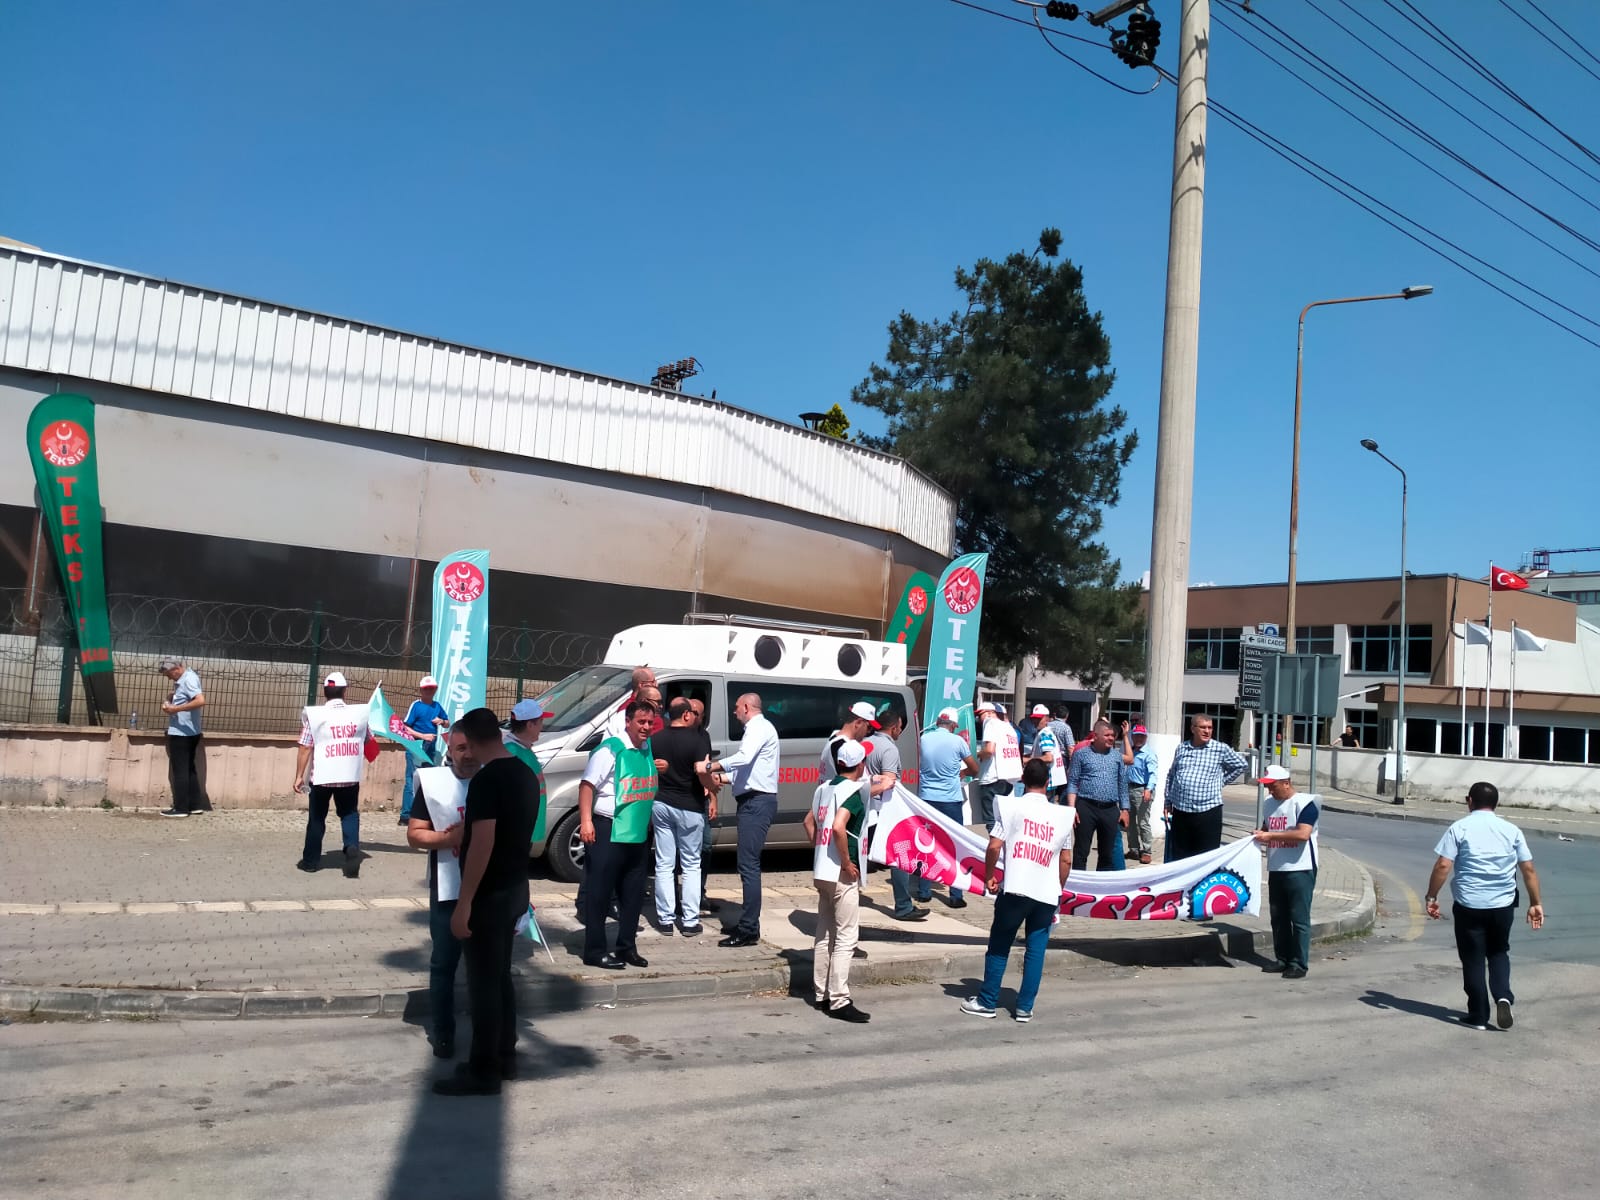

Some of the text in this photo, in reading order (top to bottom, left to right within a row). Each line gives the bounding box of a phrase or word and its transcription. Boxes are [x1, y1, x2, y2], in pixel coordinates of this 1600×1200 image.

[448, 604, 473, 722] TEKSİ
[943, 617, 967, 701] TEK
[777, 763, 820, 784] SENDİK
[1023, 818, 1054, 842] TEKSİF
